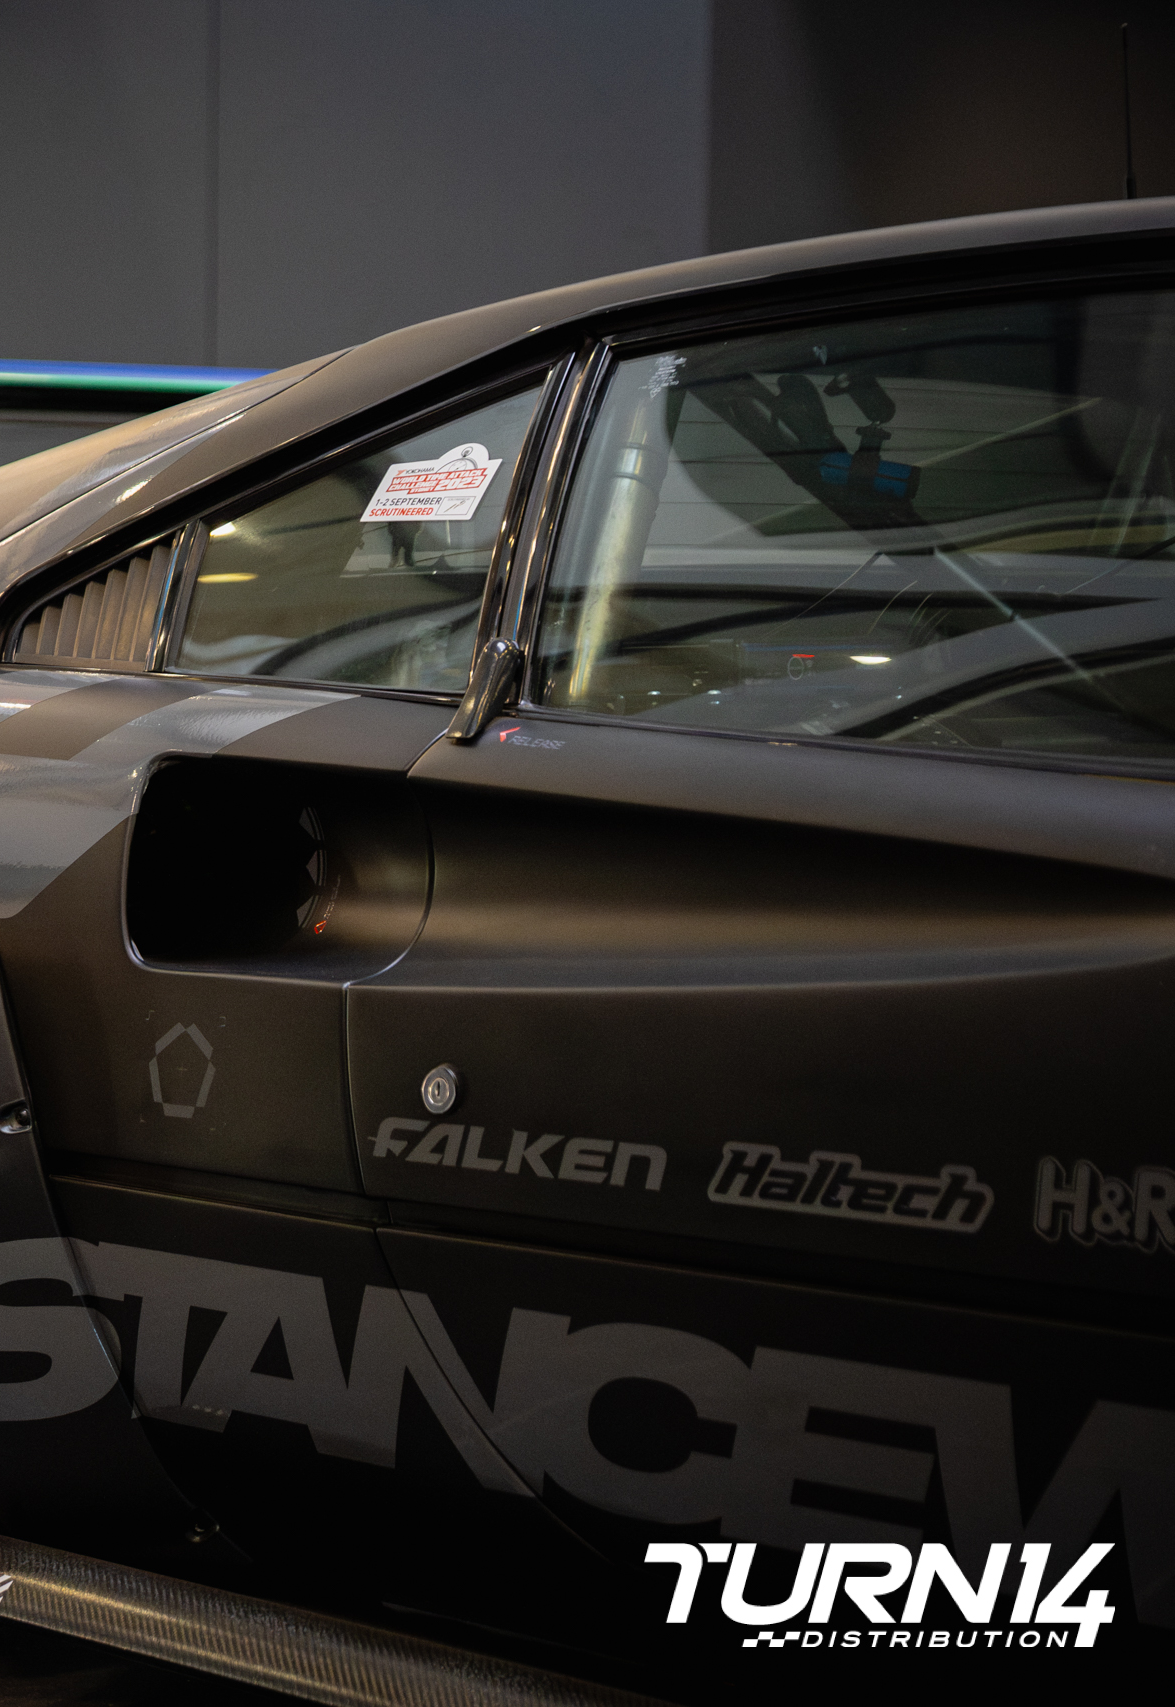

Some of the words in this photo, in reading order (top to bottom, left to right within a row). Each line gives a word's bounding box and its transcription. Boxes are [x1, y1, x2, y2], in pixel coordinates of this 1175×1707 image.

[392, 474, 425, 485] WORLD
[448, 468, 485, 479] ATTACK
[435, 475, 485, 491] 2023
[375, 498, 388, 507] 1-2
[389, 496, 442, 507] SEPTEMBER
[369, 507, 434, 517] SCRUTINEERED
[508, 735, 566, 750] RELEASE
[368, 1115, 667, 1192] FALKEN
[710, 1142, 993, 1233] Haltech
[1033, 1155, 1175, 1255] H&R
